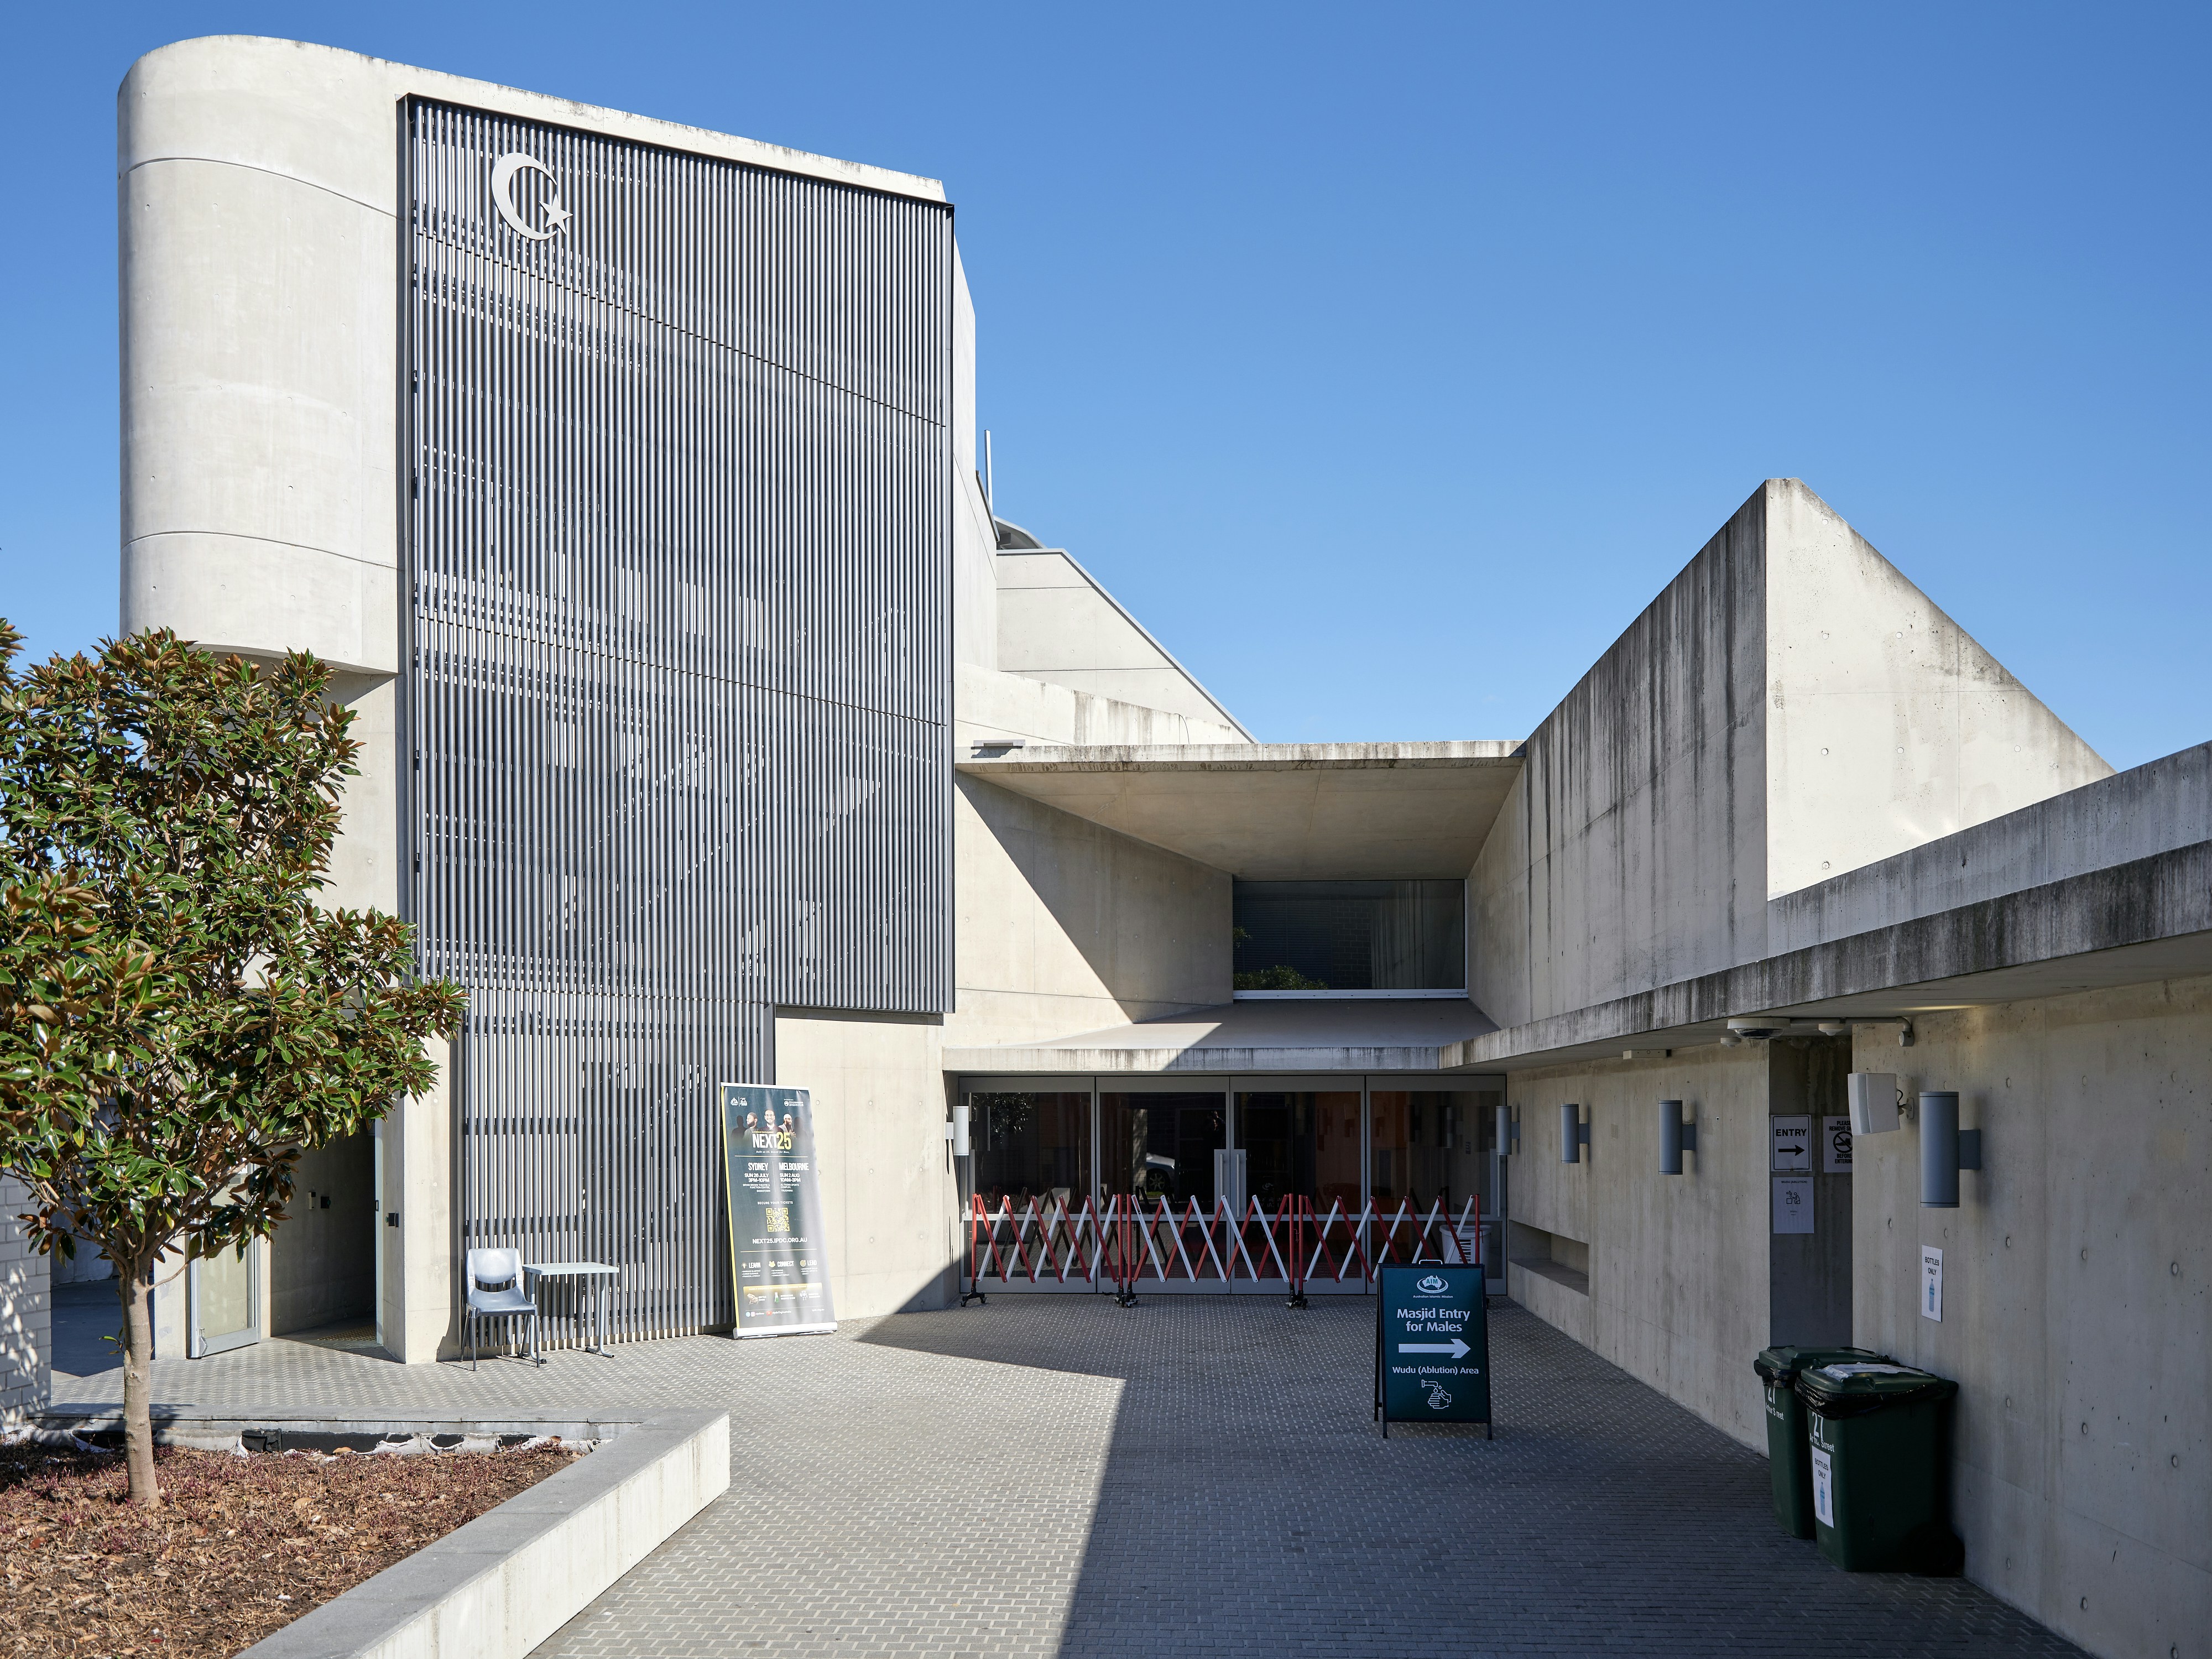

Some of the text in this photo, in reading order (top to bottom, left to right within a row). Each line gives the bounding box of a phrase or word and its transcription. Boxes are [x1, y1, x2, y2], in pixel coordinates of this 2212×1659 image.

[748, 1162, 769, 1171] SYDNEY
[779, 1162, 809, 1171] MELBOURNE
[1925, 1256, 1939, 1266] BOTTLES
[1397, 1307, 1470, 1322] Masjid Entry
[1406, 1321, 1463, 1332] for Males
[1418, 1366, 1458, 1375] (Ablution)
[1812, 1411, 1824, 1439] 27
[1821, 1438, 1835, 1453] Street
[1814, 1457, 1829, 1471] BOTTLES
[1818, 1470, 1826, 1479] ONLY
